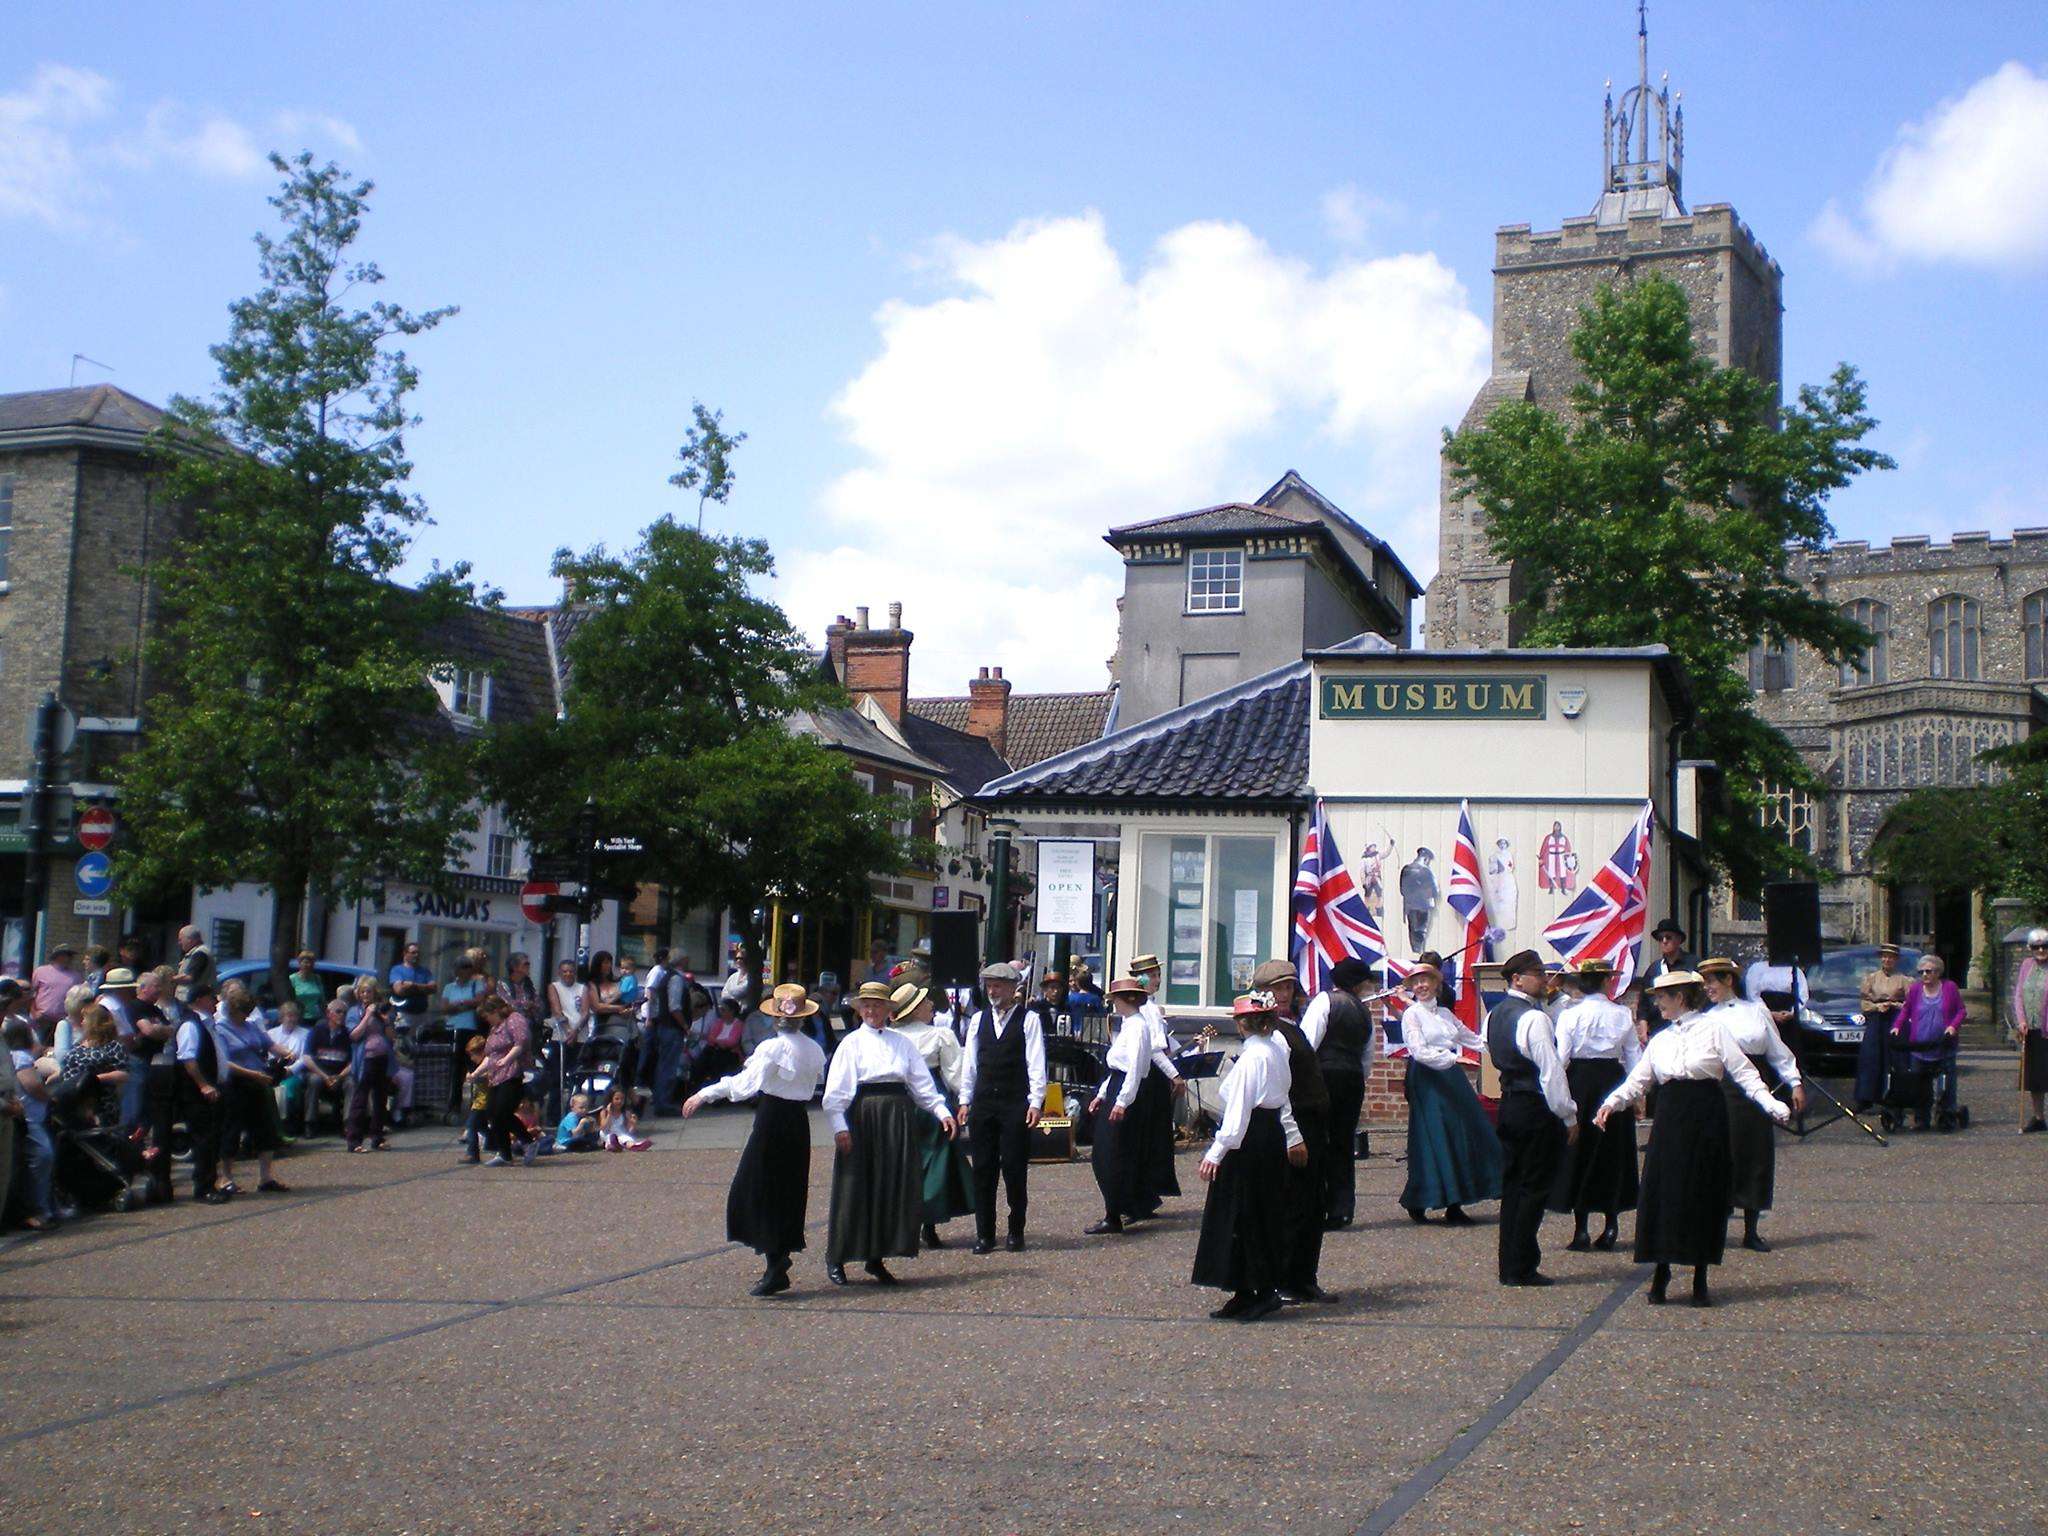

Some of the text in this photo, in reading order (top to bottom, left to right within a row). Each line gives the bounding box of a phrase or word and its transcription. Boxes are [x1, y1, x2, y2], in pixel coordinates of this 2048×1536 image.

[1331, 683, 1535, 711] MUSEUM
[1048, 883, 1082, 891] OPEN
[413, 892, 491, 922] SANDA'S
